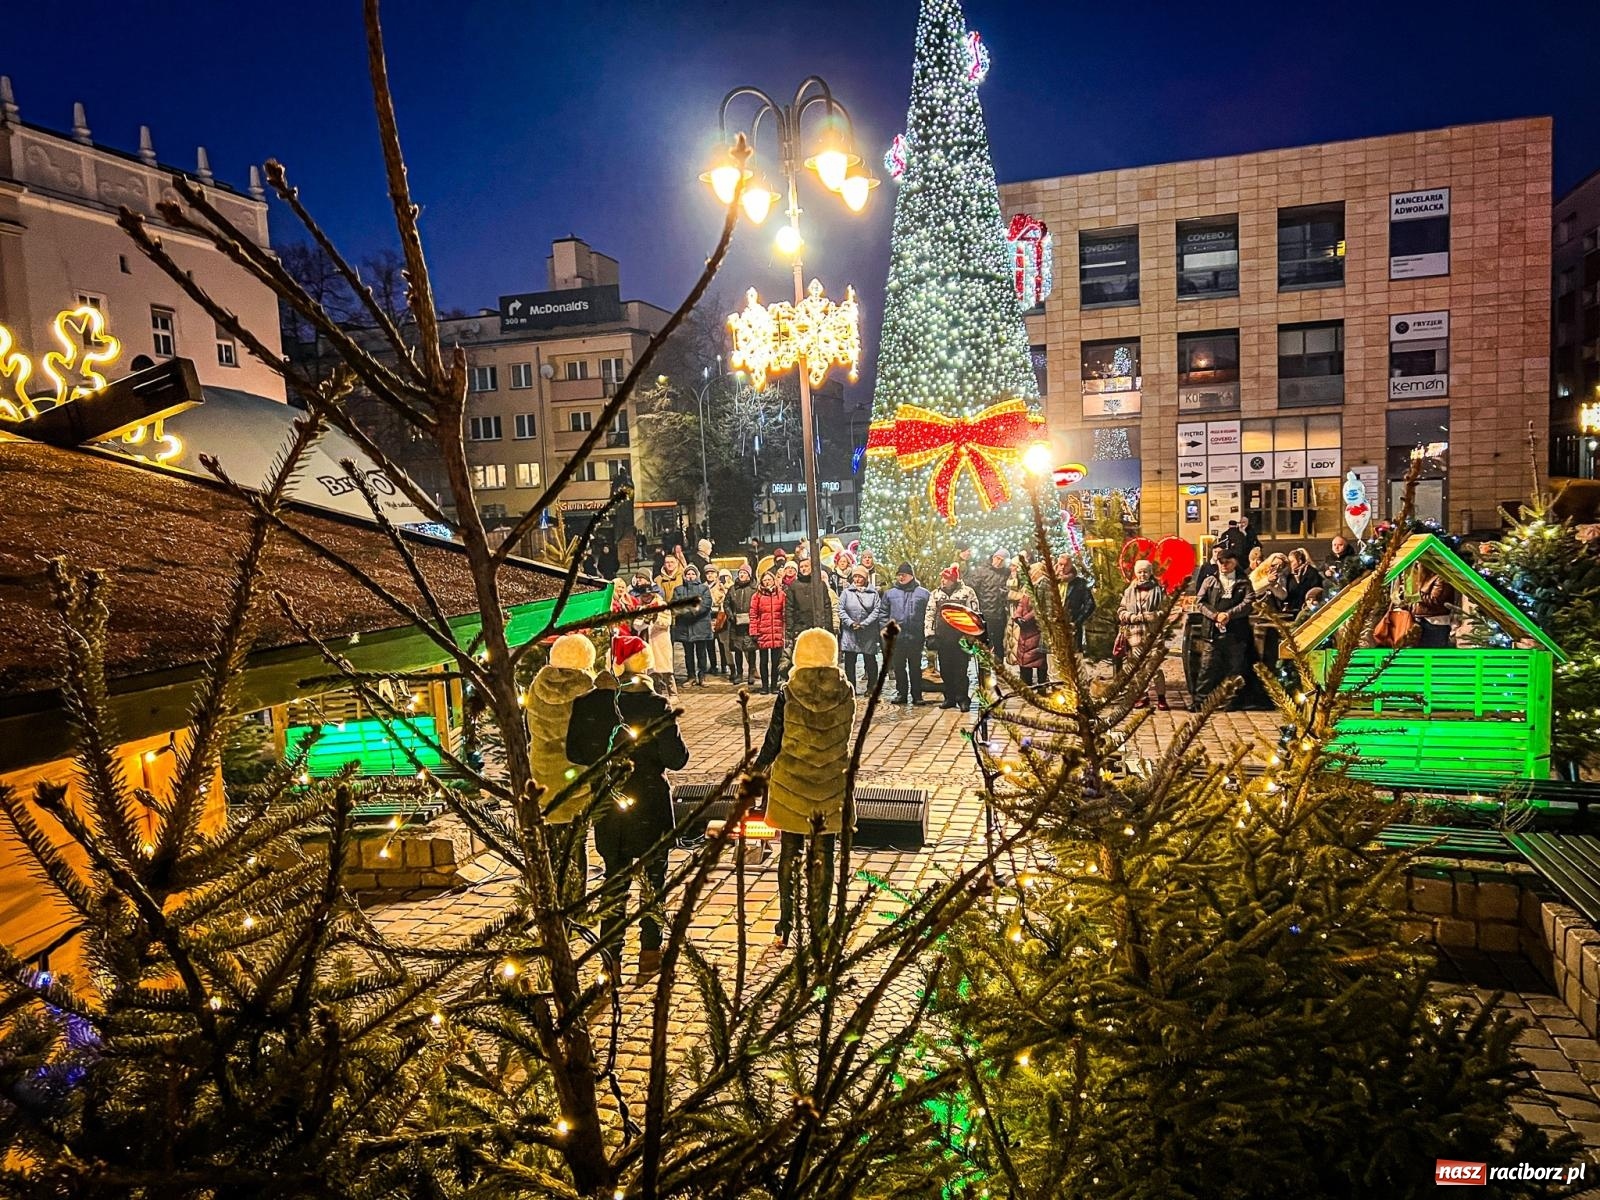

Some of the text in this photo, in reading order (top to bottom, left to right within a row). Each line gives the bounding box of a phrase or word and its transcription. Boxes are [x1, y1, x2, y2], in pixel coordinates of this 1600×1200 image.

[1395, 193, 1443, 205] KANCELARIA
[1394, 203, 1444, 215] ADWOKACKA
[1187, 231, 1225, 242] COVEBO
[529, 300, 590, 316] McDonald's
[771, 483, 793, 493] DREAM
